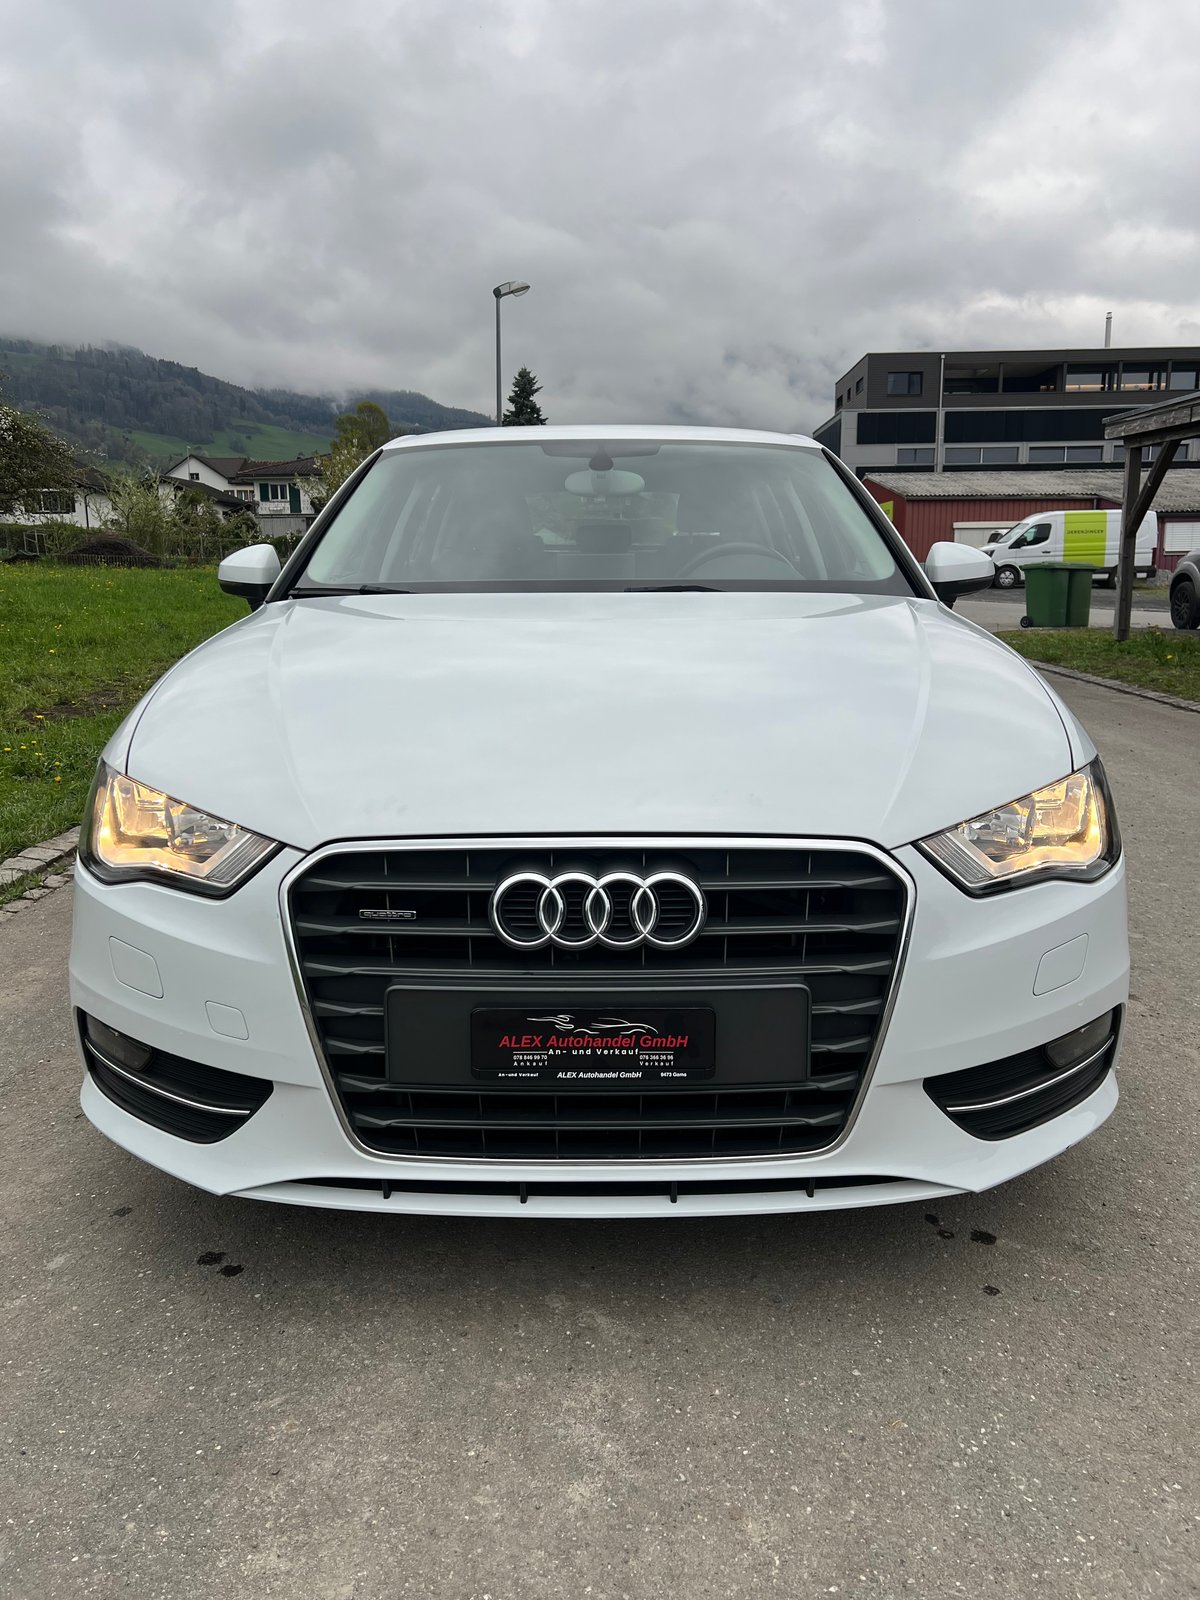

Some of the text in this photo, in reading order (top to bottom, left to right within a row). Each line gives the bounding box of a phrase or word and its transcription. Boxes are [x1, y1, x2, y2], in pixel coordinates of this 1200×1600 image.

[499, 1035, 689, 1048] ALEX Autohandel GmbH
